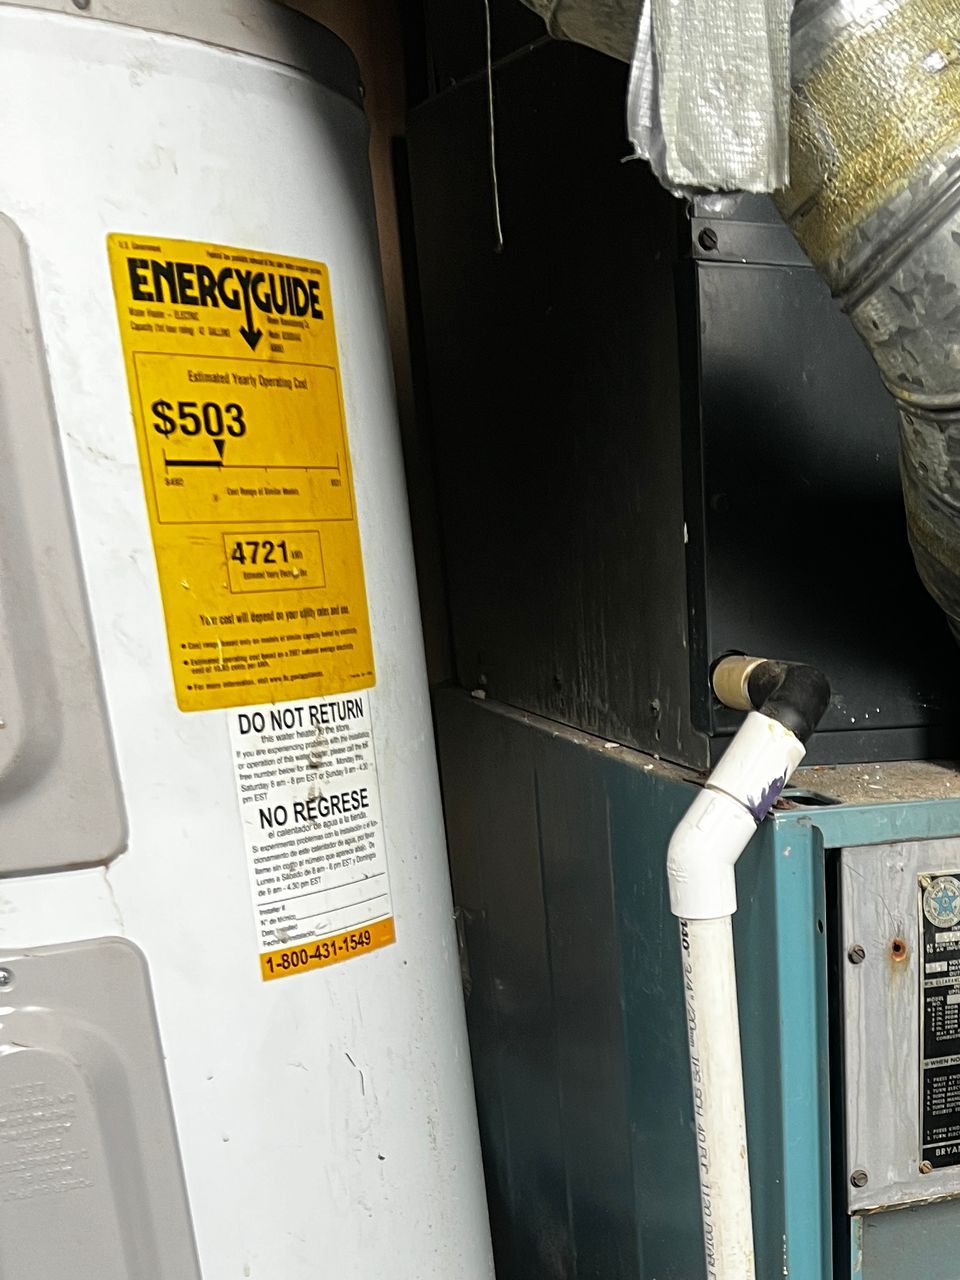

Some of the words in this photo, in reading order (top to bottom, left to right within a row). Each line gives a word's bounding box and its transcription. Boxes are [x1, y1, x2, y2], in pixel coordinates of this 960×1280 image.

[126, 257, 324, 322] ENERGYGUIDE
[187, 369, 229, 385] Estimated
[232, 373, 257, 389] Yearly
[258, 374, 293, 391] Operating
[293, 377, 308, 390] Cost
[151, 398, 247, 440] $503
[231, 540, 288, 565] 4721
[219, 612, 234, 625] cost
[236, 611, 249, 624] will
[250, 610, 275, 624] depend
[276, 611, 285, 621] on
[285, 610, 299, 623] your
[238, 712, 266, 735] DO
[270, 707, 304, 732] NOT
[308, 697, 364, 726] RETURN
[260, 734, 275, 744] this
[275, 732, 296, 742] water
[296, 728, 317, 739] heater
[325, 725, 336, 734] the
[242, 750, 255, 759] you
[267, 742, 305, 756] experiencing
[246, 758, 276, 770] operation
[253, 769, 278, 780] number
[278, 766, 296, 776] below
[240, 782, 269, 793] Saturday
[305, 772, 317, 783] EST
[254, 791, 269, 802] EST
[258, 805, 288, 830] NO
[292, 788, 369, 824] REGRESE
[275, 824, 312, 838] calentador
[323, 819, 339, 830] agua
[296, 833, 324, 846] problemas
[310, 875, 322, 887] EST
[266, 929, 372, 974] 1-800-431-1549
[930, 1057, 949, 1067] WHEN
